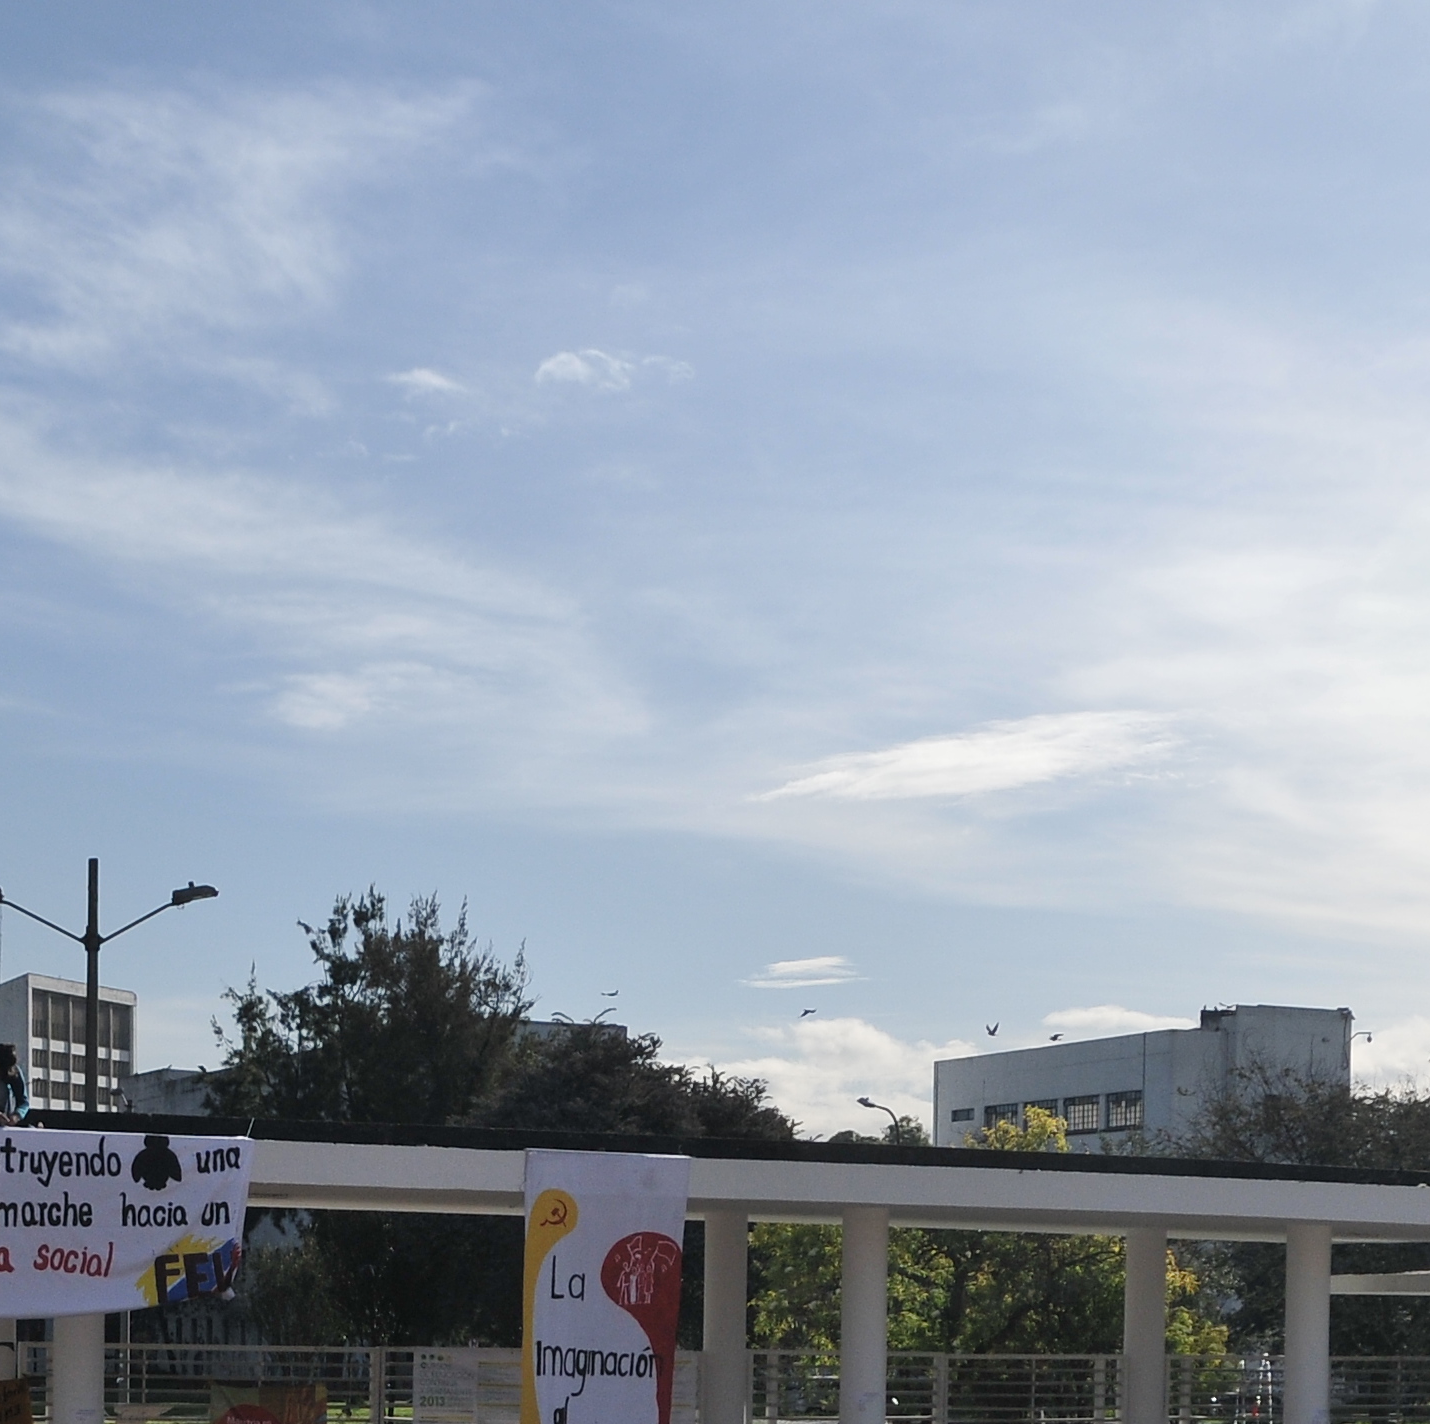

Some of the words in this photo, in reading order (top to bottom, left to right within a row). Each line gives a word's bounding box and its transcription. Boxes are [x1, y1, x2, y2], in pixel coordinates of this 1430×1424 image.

[196, 1145, 241, 1172] una
[121, 1193, 188, 1227] hacia
[201, 1199, 231, 1226] un
[33, 1241, 114, 1278] social
[550, 1255, 586, 1301] La
[535, 1337, 663, 1396] Imaginación
[419, 1395, 446, 1407] 2013
